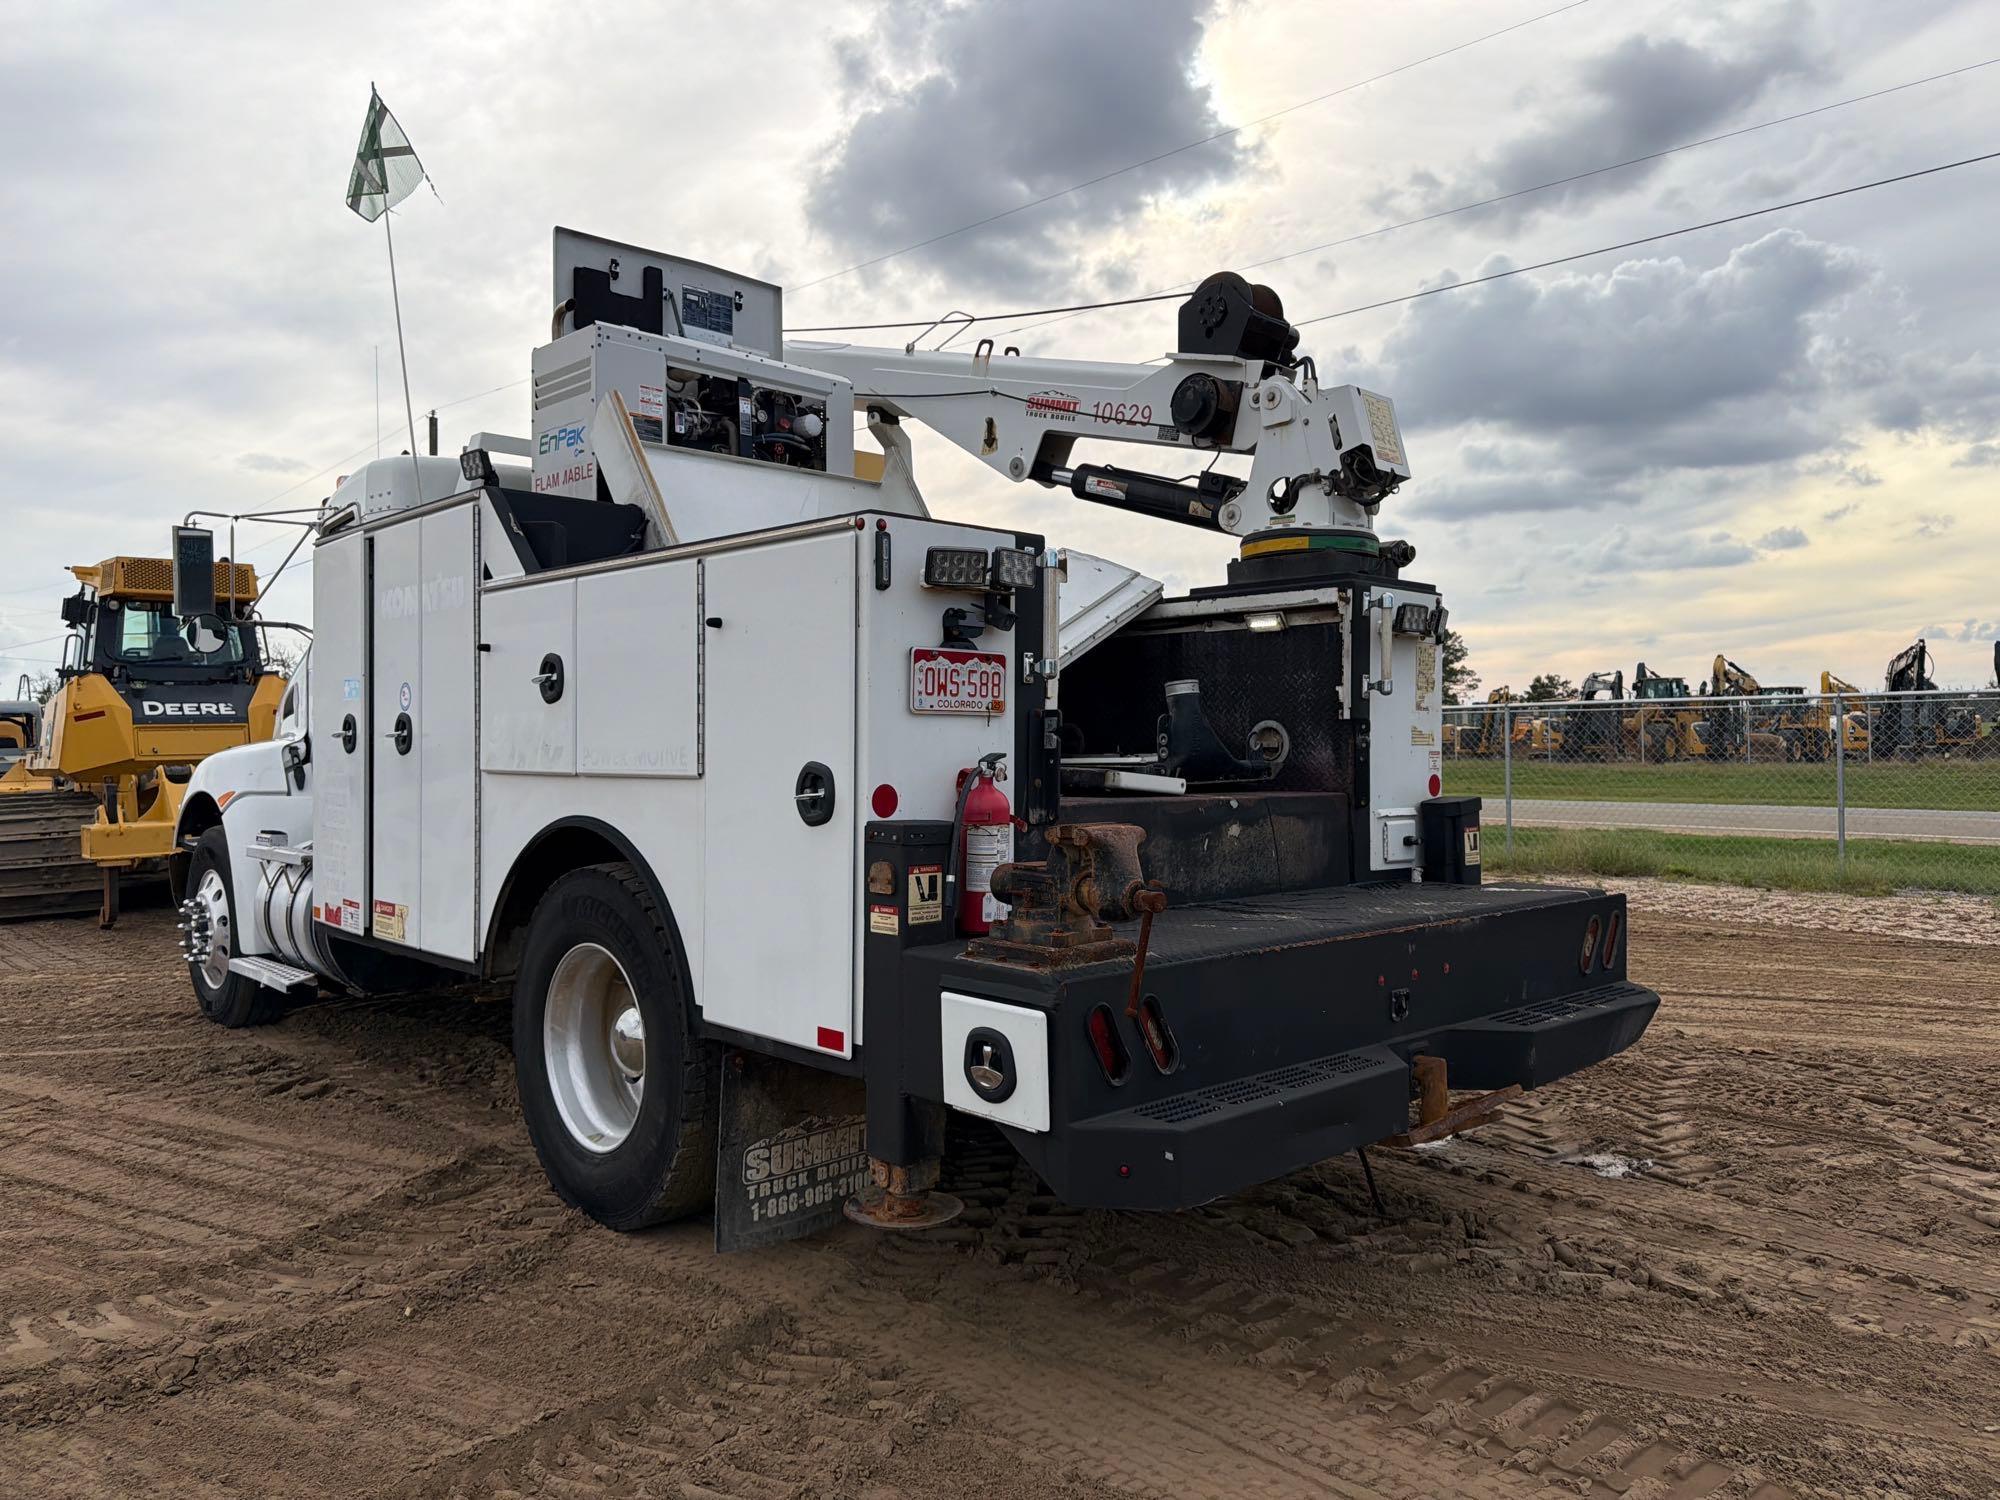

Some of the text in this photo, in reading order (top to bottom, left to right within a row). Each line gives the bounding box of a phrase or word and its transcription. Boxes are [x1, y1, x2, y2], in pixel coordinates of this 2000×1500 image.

[1026, 397, 1080, 414] SUMMIT
[1093, 401, 1152, 427] 10629
[1026, 411, 1077, 422] TRUCK BODIES
[539, 426, 586, 455] EnPak
[142, 701, 236, 716] DEERE
[937, 699, 983, 709] COLORADO
[747, 1154, 870, 1200] TRUCK BODIE
